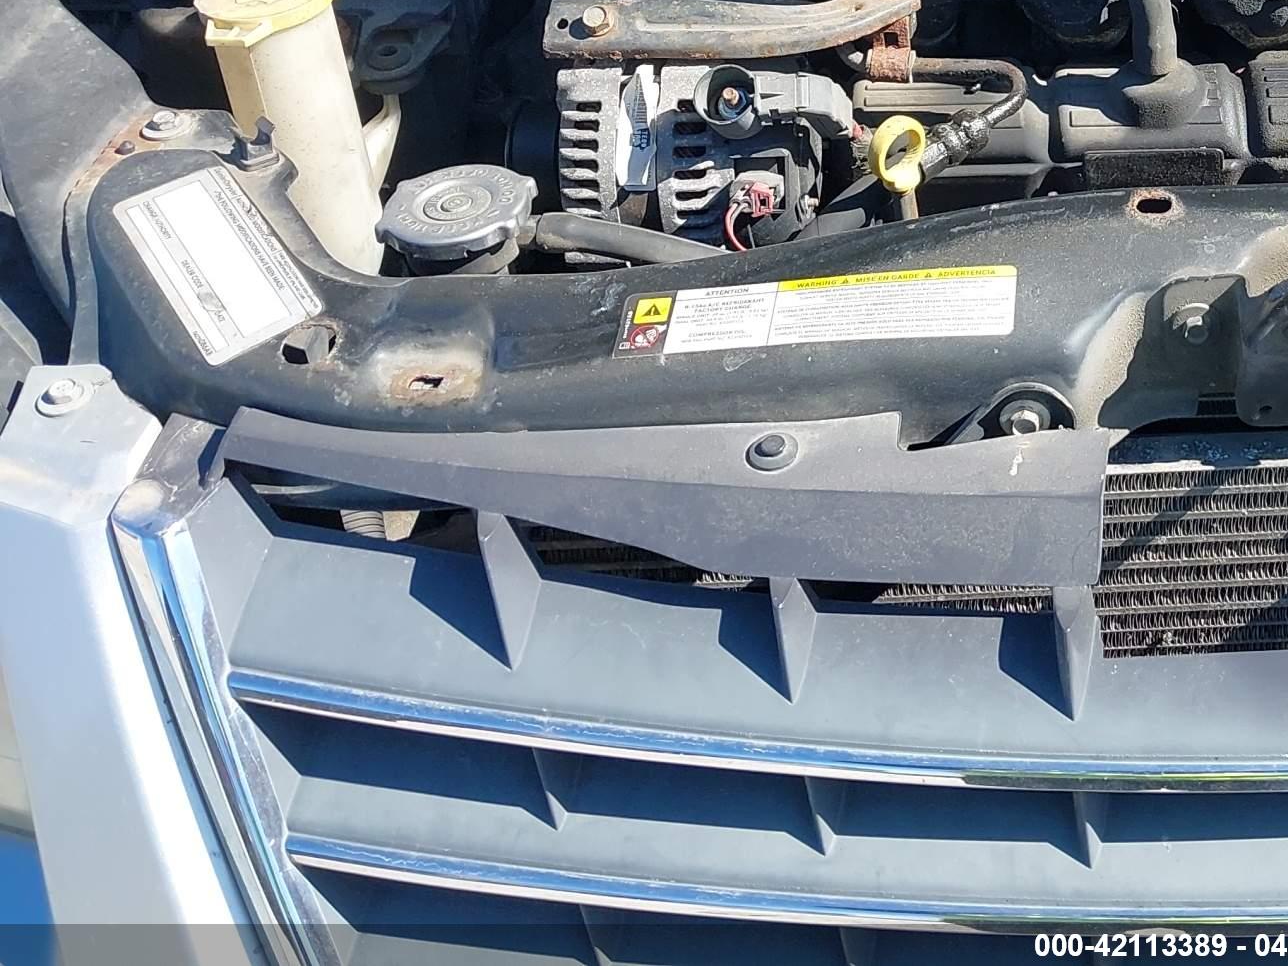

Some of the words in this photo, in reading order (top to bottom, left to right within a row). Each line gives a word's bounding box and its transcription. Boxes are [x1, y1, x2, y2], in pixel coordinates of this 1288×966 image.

[180, 259, 196, 276] DEALER
[190, 274, 204, 288] CODE
[796, 280, 838, 289] WARNING
[855, 275, 875, 284] MISE
[877, 274, 890, 282] EN
[891, 272, 919, 281] GARDE
[938, 268, 996, 278] ADVERTENCIA
[704, 287, 750, 297] ATTENTION
